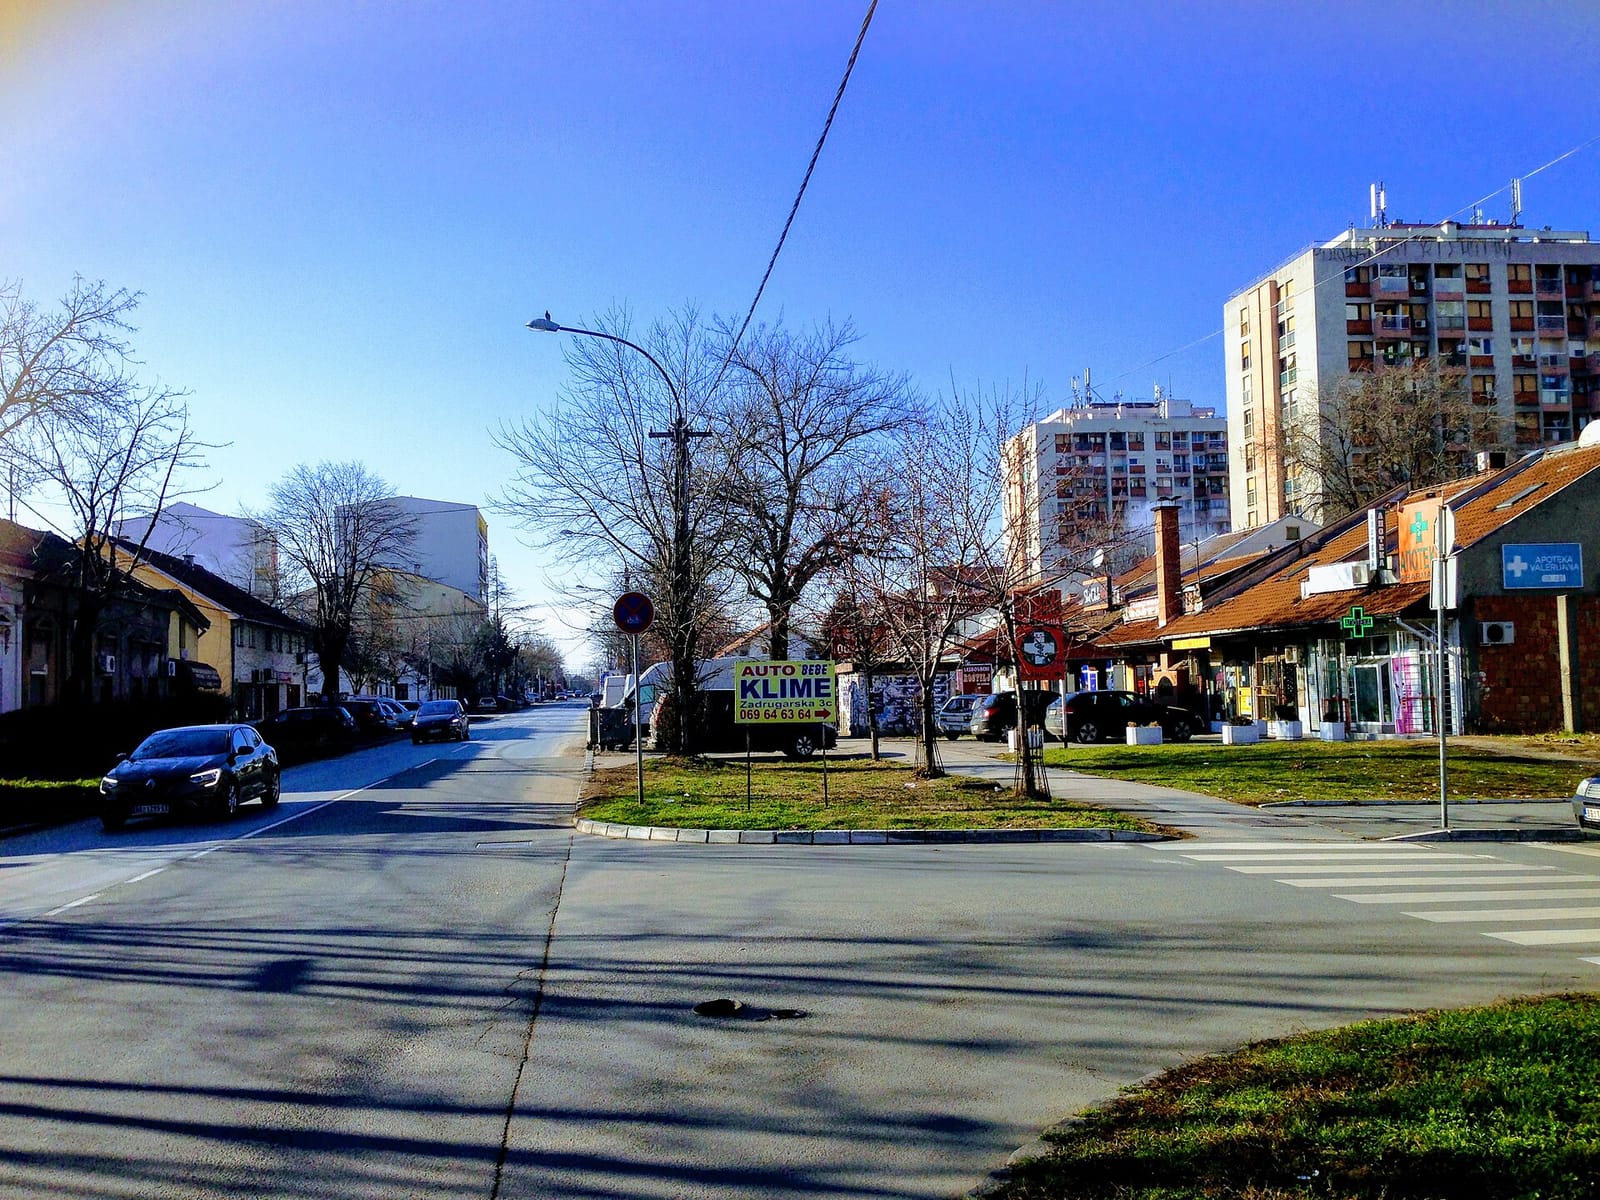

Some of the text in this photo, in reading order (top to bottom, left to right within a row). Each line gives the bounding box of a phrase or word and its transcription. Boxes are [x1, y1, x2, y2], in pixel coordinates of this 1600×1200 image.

[1535, 555, 1573, 563] APOTEKA
[742, 665, 796, 676] AUTO
[741, 678, 832, 699] KLIME
[740, 700, 815, 710] Zadrugarska
[740, 709, 811, 720] 069 64 63 64
